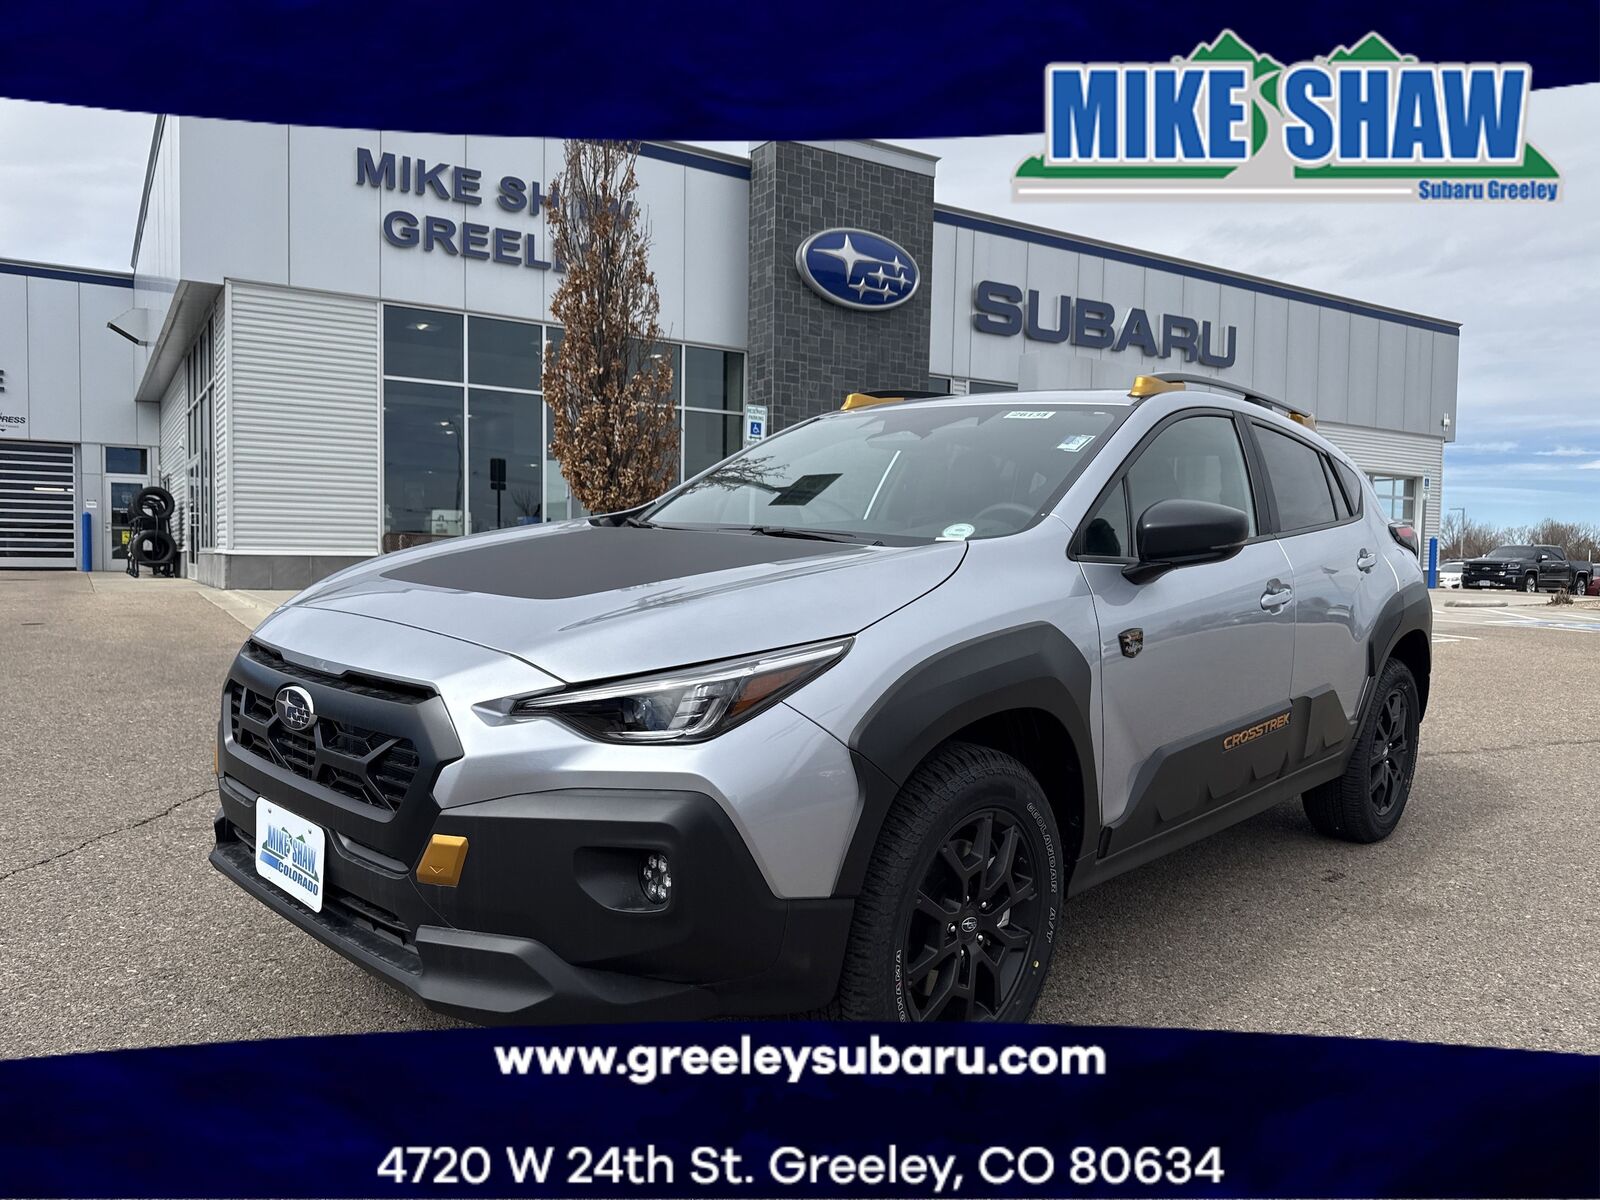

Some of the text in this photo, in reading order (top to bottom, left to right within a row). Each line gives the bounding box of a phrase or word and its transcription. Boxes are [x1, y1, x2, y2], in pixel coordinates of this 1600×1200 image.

[355, 147, 482, 205] MIKE
[383, 210, 612, 278] GREEL
[973, 280, 1237, 368] SUBARU
[1223, 712, 1290, 750] CROSSTREK
[267, 824, 317, 874] MIKE SHAW
[1026, 802, 1057, 893] GEOLANDAR
[278, 861, 319, 897] COLORADO
